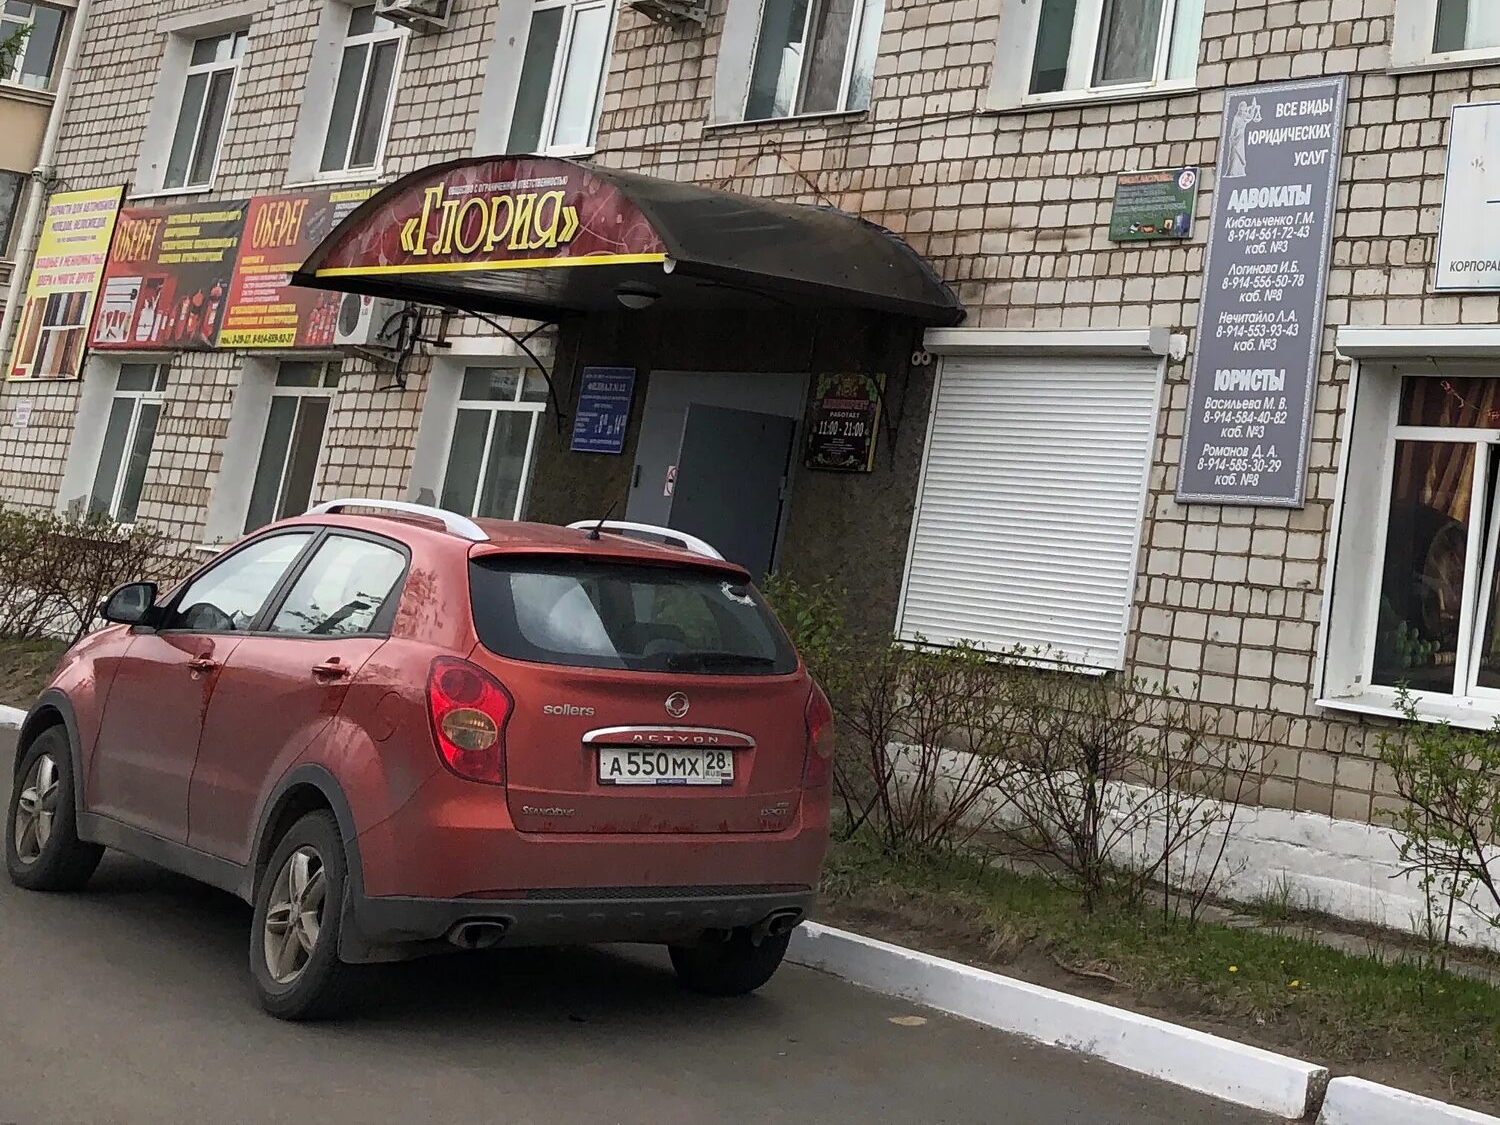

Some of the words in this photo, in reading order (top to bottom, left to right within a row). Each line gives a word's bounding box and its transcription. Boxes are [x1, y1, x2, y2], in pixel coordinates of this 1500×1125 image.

[1275, 101, 1298, 118] ВСЕ
[1299, 97, 1334, 115] ВИДЫ
[1247, 123, 1331, 146] ЮРИДИЧЕСКИХ
[1293, 149, 1328, 167] УСЛУГ
[1227, 183, 1313, 213] АДВОКАТЫ
[252, 198, 309, 249] ОБЕРЕГ
[1225, 214, 1294, 229] Кибальченко
[1227, 225, 1310, 242] 8-914-561-72-43
[1245, 241, 1267, 254] каб.
[1228, 262, 1279, 276] Логинова
[1221, 274, 1304, 290] 8-914-556-50-78
[1239, 289, 1262, 302] каб.
[1219, 310, 1275, 324] Нечитайло
[1216, 323, 1299, 338] 8-914-553-93-43
[1233, 339, 1256, 351] каб.
[1213, 368, 1286, 392] ЮРИСТЫ
[1204, 397, 1262, 410] Васильева
[1203, 411, 1288, 424] 8-914-584-40-82
[1220, 426, 1243, 438] каб.
[1202, 443, 1249, 457] Романов
[1197, 458, 1282, 473] 8-914-585-30-29
[1214, 474, 1238, 486] каб.
[543, 704, 596, 717] sollers
[705, 751, 726, 771] 28
